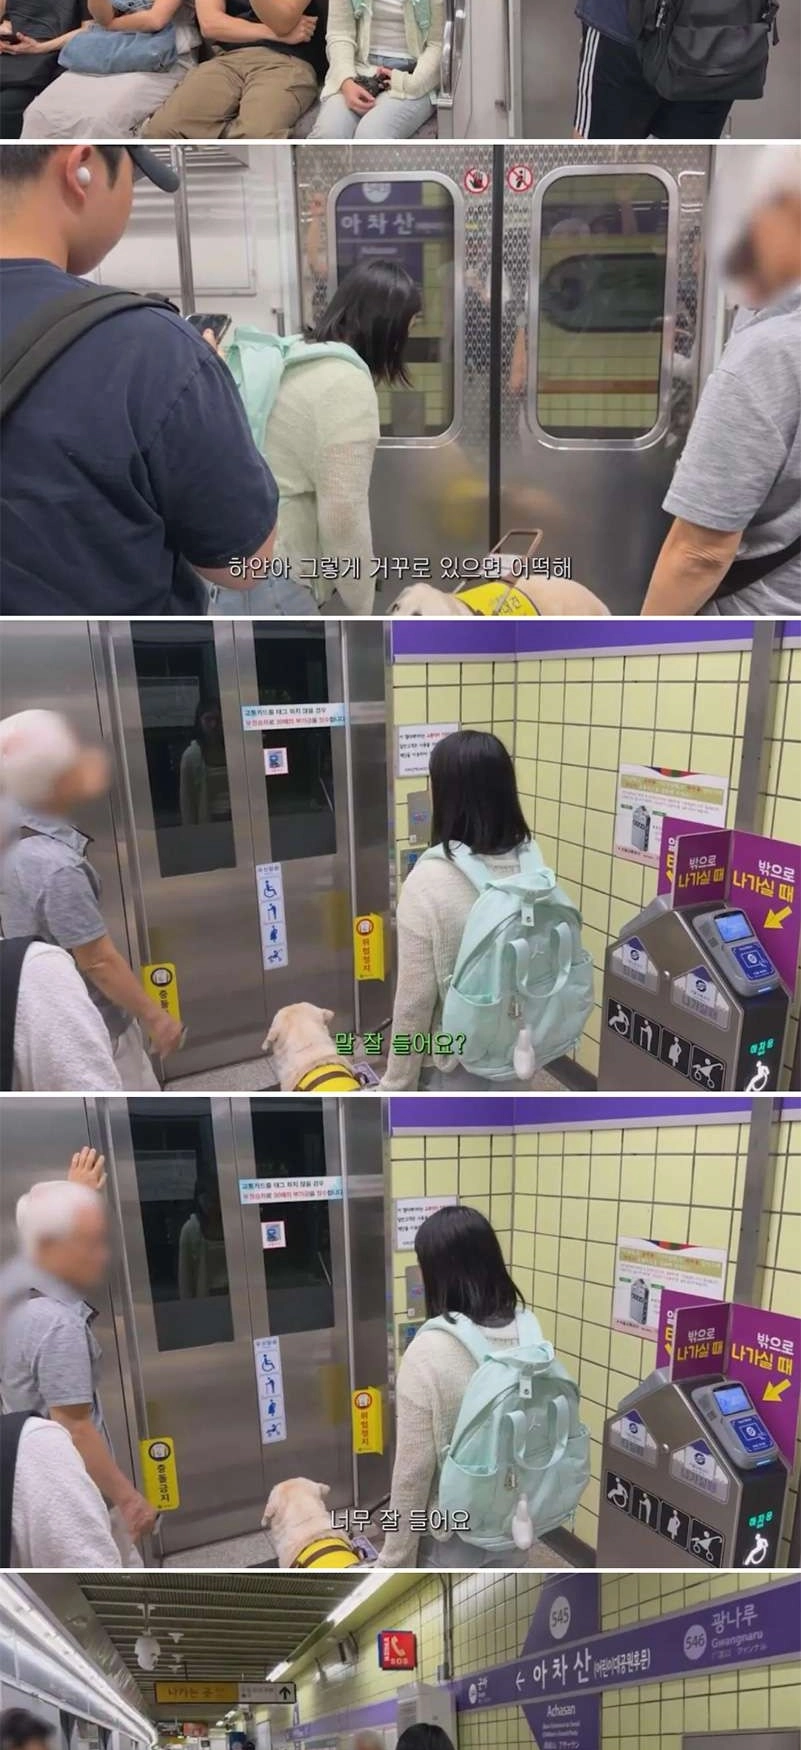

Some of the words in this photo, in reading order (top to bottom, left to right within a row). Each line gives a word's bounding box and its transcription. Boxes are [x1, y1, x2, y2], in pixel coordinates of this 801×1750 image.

[689, 855, 716, 870] 밖으로
[758, 859, 795, 883] 밖으로
[678, 870, 711, 888] 나가실
[733, 870, 774, 898] 나가실
[779, 883, 794, 903] 때
[688, 1328, 716, 1342] 밖으로
[757, 1332, 794, 1355] 밖으로
[677, 1345, 710, 1361] 나가실
[731, 1343, 773, 1370] 나가실
[777, 1354, 792, 1375] 때
[552, 1607, 570, 1628] 545
[712, 1604, 759, 1634] 광나루
[685, 1634, 706, 1650] 546
[712, 1631, 763, 1649] Gwangnaru
[533, 1648, 592, 1690] 아차산
[547, 1703, 576, 1717] Achasan
